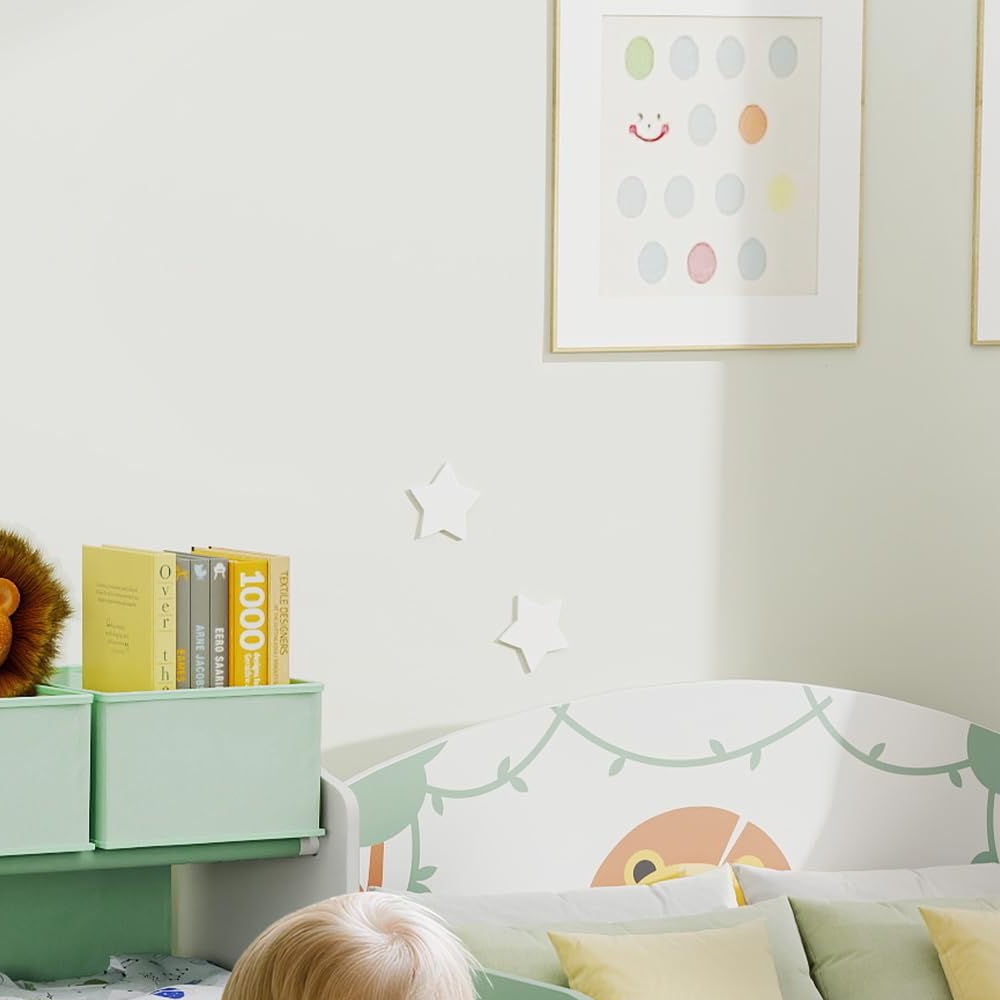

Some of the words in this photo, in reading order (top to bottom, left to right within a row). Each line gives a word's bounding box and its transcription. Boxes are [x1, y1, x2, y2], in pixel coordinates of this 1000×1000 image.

[279, 571, 288, 606] TEXTILE
[239, 570, 265, 651] 1000
[195, 624, 205, 651] ARNE
[215, 627, 225, 653] EERO
[279, 607, 288, 656] DESIGNERS
